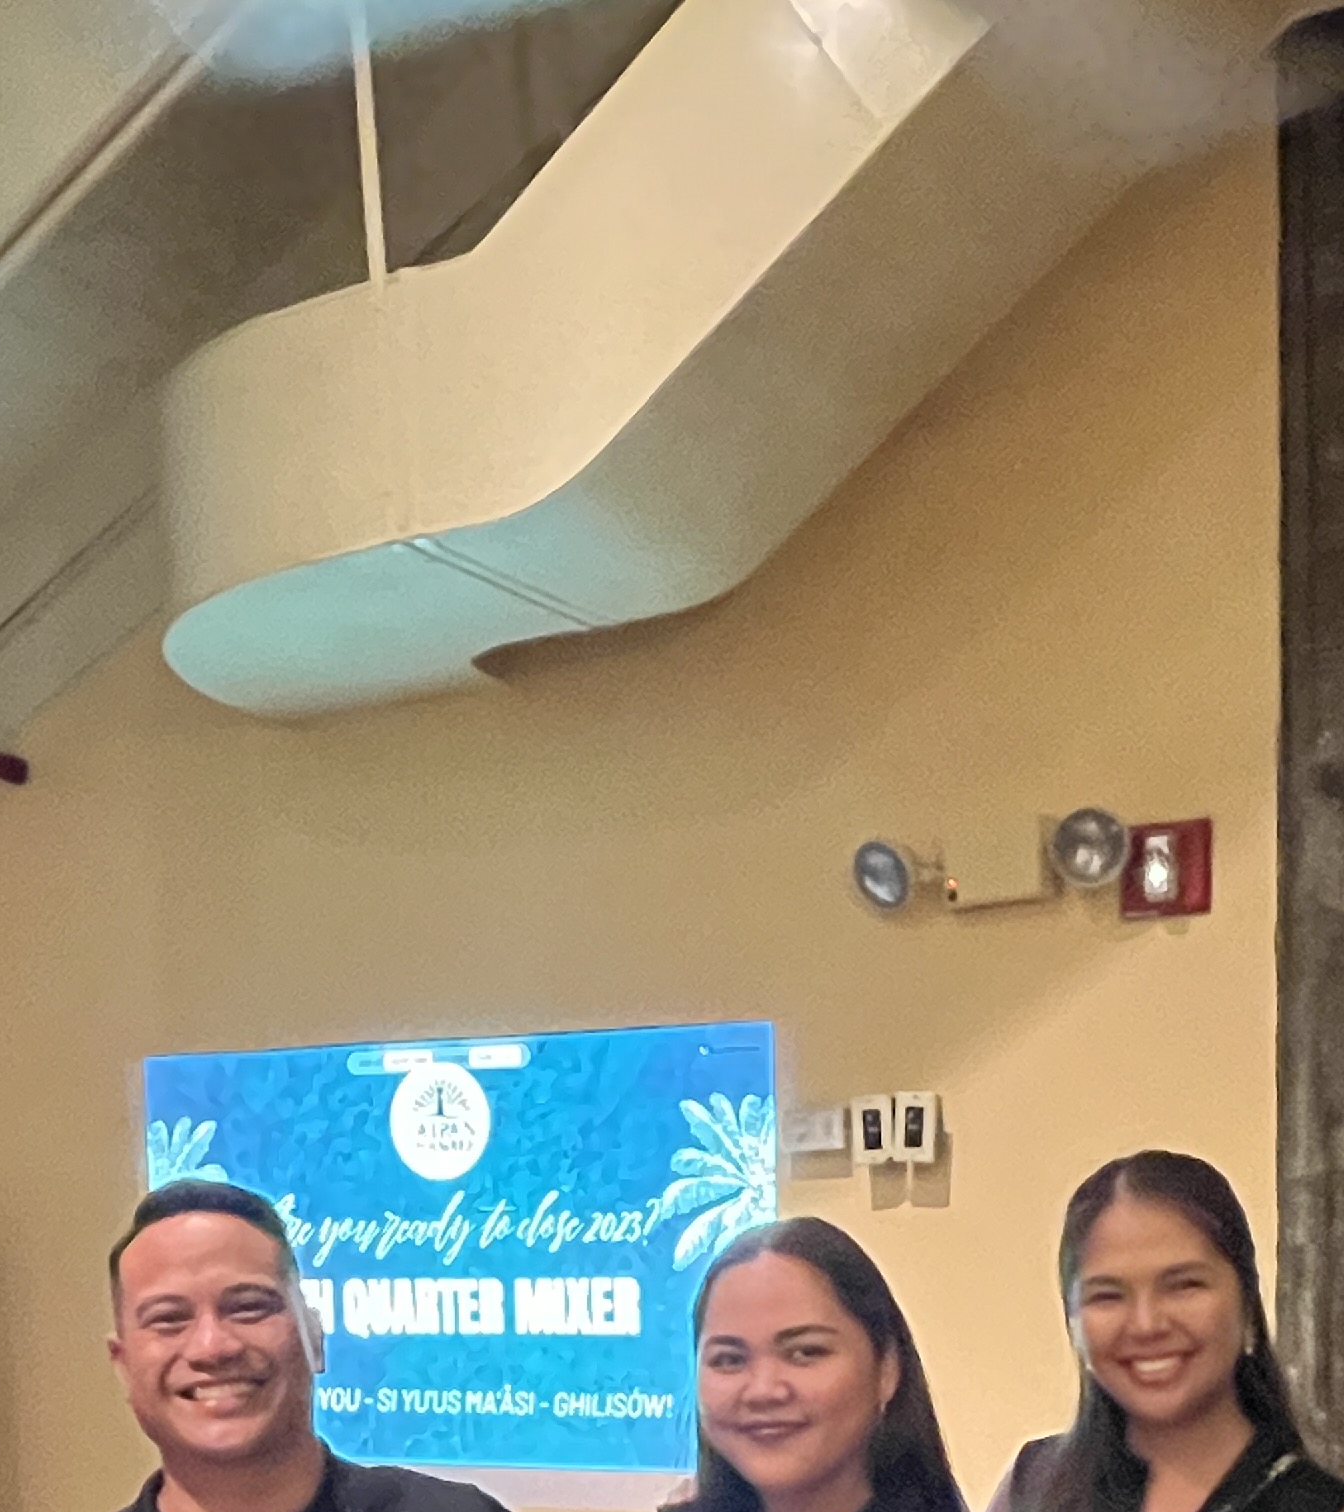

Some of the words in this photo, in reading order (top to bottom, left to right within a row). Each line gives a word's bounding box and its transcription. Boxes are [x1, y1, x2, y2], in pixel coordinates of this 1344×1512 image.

[312, 1216, 381, 1268] you
[374, 1190, 474, 1266] ready
[477, 1199, 517, 1249] to
[516, 1190, 585, 1254] close
[582, 1198, 662, 1248] 2023?
[342, 1277, 505, 1339] QUARTER
[513, 1277, 642, 1337] MIXER
[317, 1386, 362, 1413] YOU
[376, 1386, 398, 1414] SI
